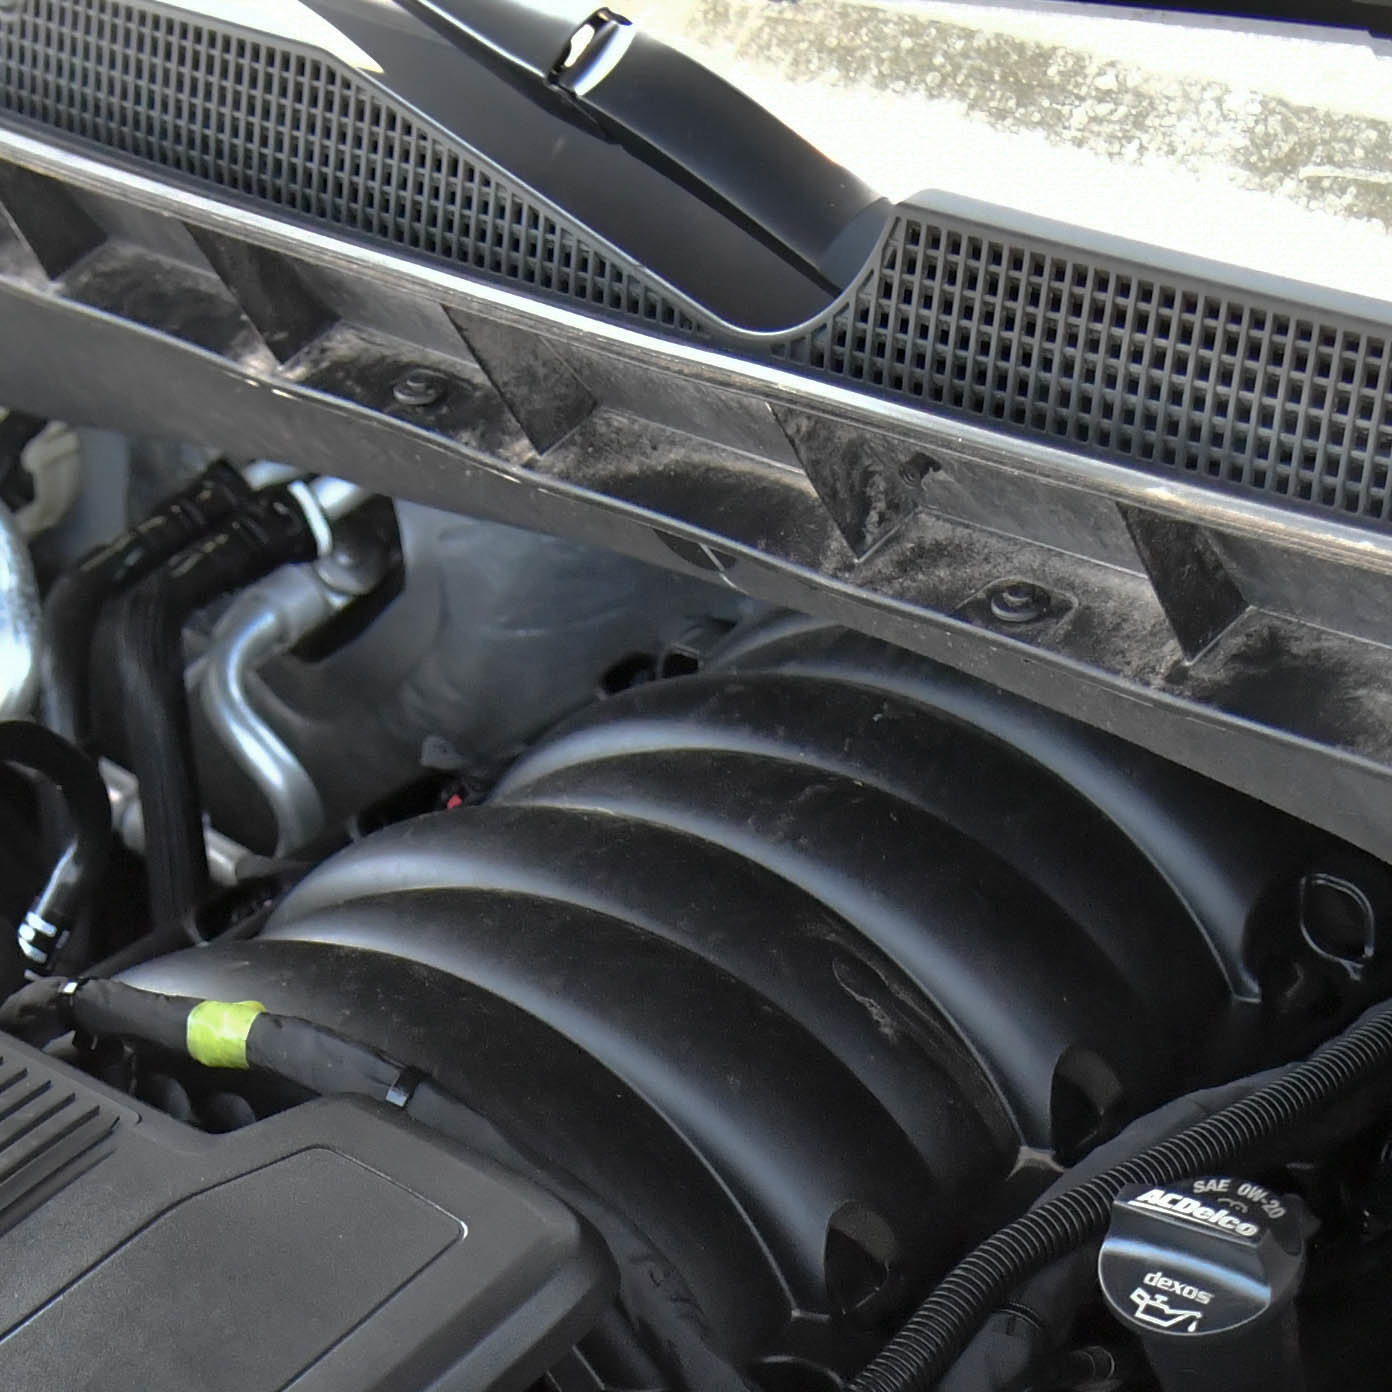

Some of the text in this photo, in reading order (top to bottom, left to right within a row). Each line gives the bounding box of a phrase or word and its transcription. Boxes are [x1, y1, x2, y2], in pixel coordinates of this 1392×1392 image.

[1135, 1188, 1258, 1237] ACDelco
[1193, 1179, 1286, 1218] SAE 0W-20
[1143, 1272, 1212, 1304] dexos
